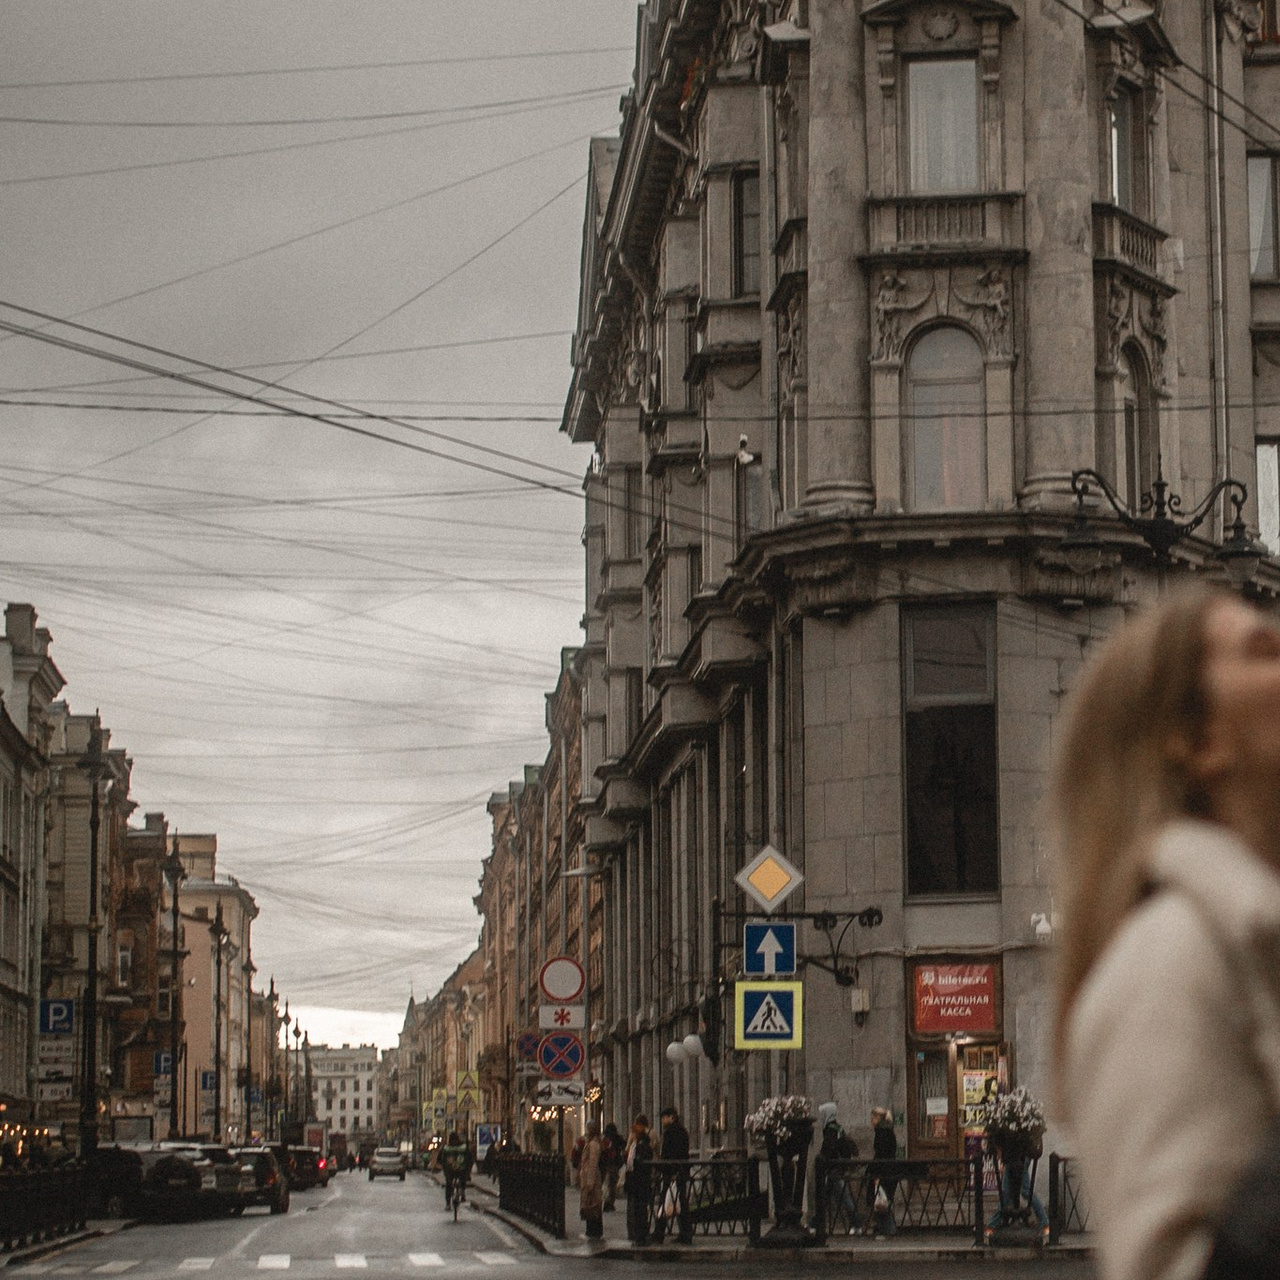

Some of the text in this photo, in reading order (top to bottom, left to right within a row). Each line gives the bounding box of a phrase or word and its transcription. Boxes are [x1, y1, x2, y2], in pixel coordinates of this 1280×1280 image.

[938, 975, 988, 985] bileter.ru
[922, 995, 989, 1005] ТЕАТРАЛЬНАЯ
[49, 1003, 68, 1030] P
[940, 1007, 971, 1016] КАССА
